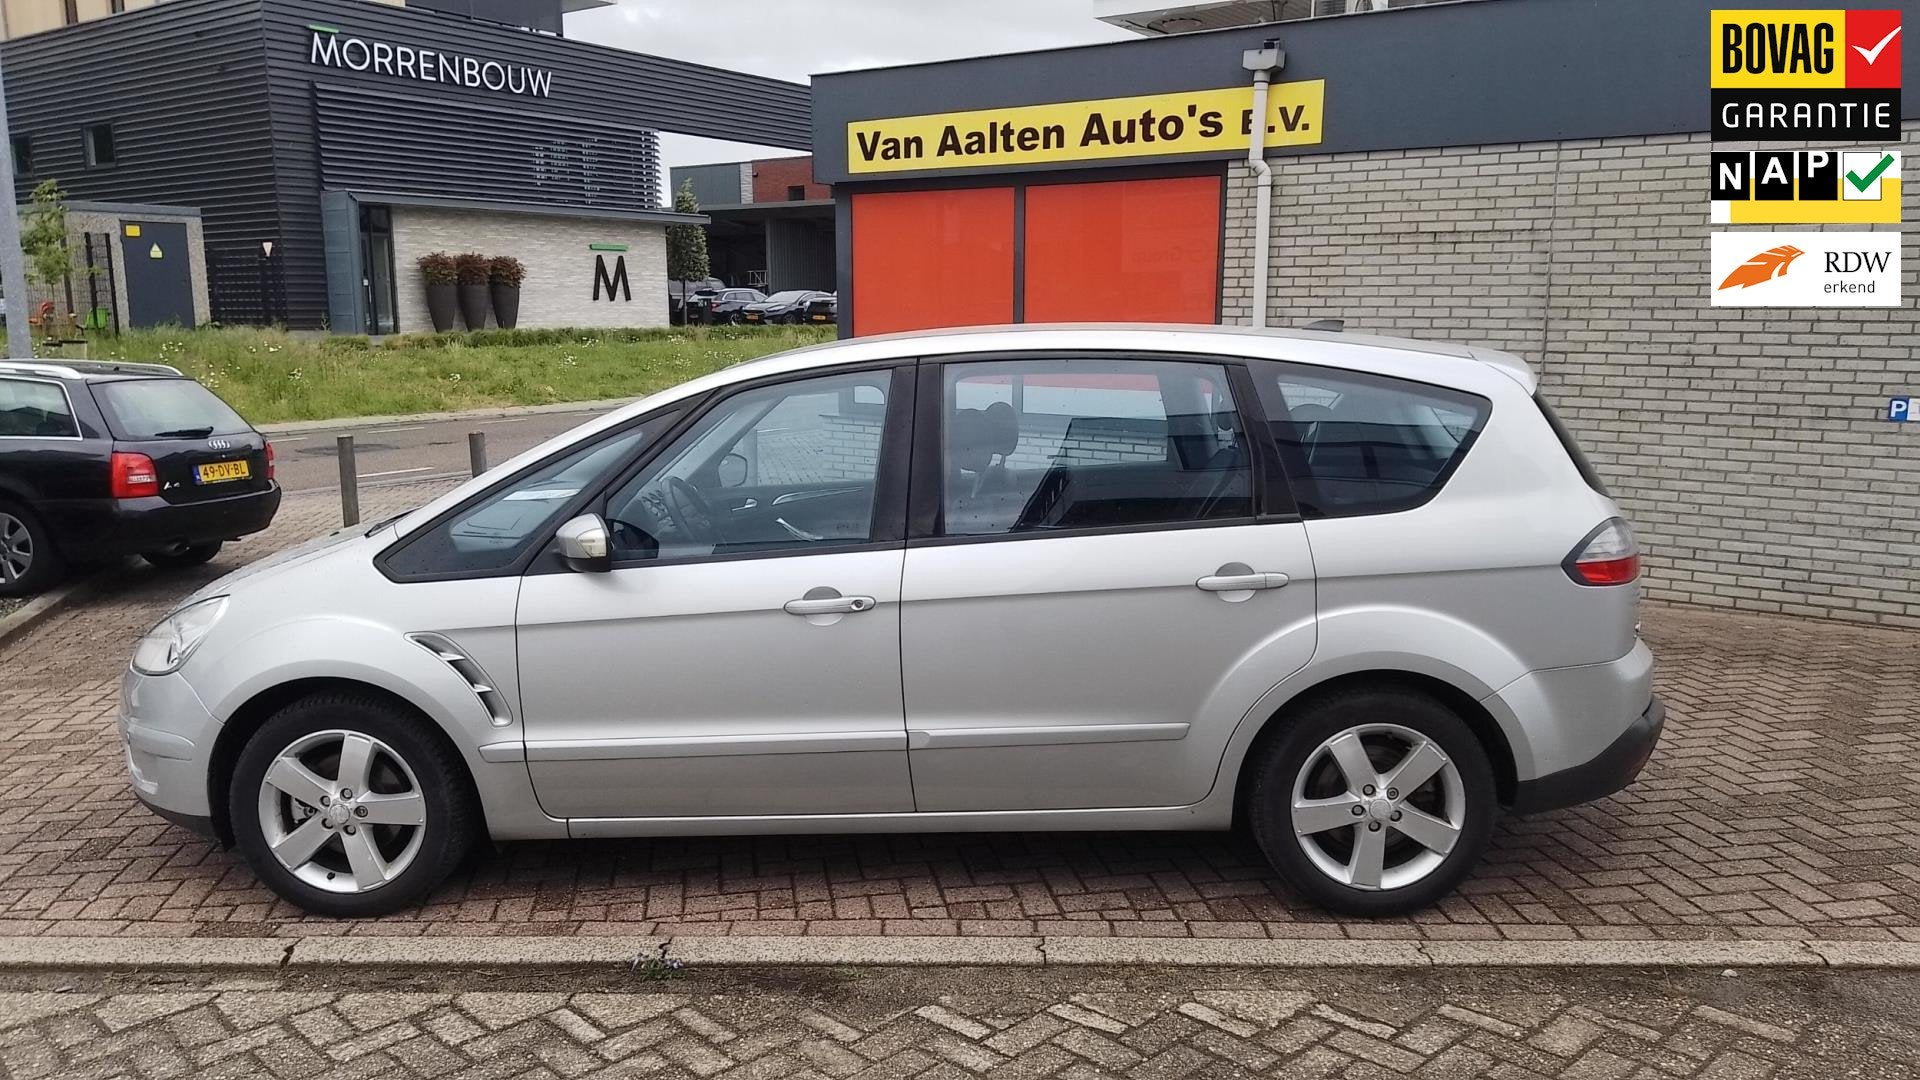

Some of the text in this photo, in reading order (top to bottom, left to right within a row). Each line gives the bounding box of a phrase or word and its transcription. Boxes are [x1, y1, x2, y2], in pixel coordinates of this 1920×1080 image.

[311, 32, 552, 98] MORRENBOUW
[857, 131, 924, 161] Van
[936, 121, 1066, 157] Aalten
[1079, 104, 1224, 147] Auto's
[593, 254, 632, 301] M
[1890, 400, 1907, 418] P
